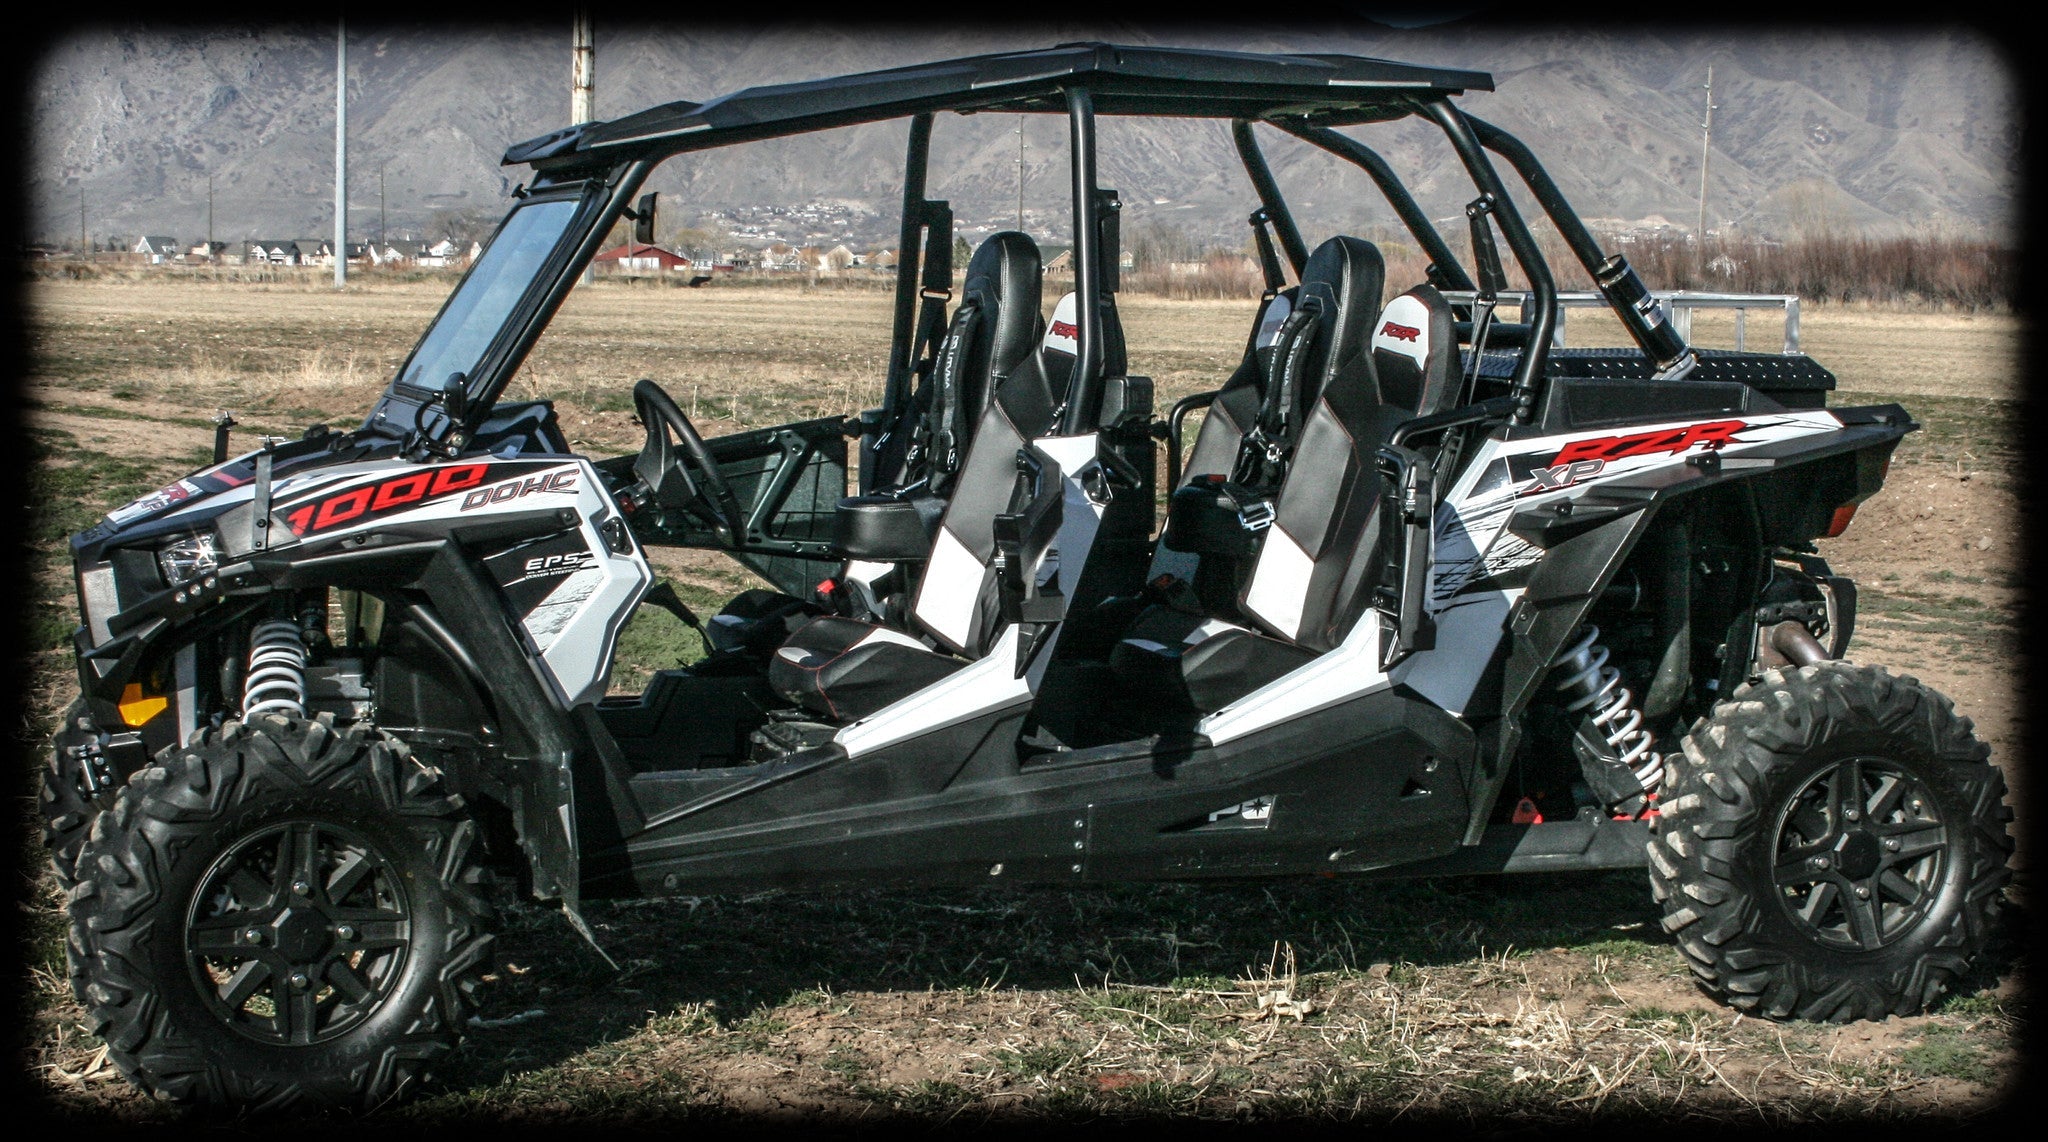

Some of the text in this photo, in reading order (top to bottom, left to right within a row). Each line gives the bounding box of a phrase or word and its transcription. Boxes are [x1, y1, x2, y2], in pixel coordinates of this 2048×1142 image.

[1379, 320, 1421, 343] RZR
[1549, 419, 1748, 467] RZR
[460, 468, 580, 512] DOHC
[1519, 458, 1605, 495] XP
[287, 463, 490, 537] 1000
[525, 551, 582, 571] EPS
